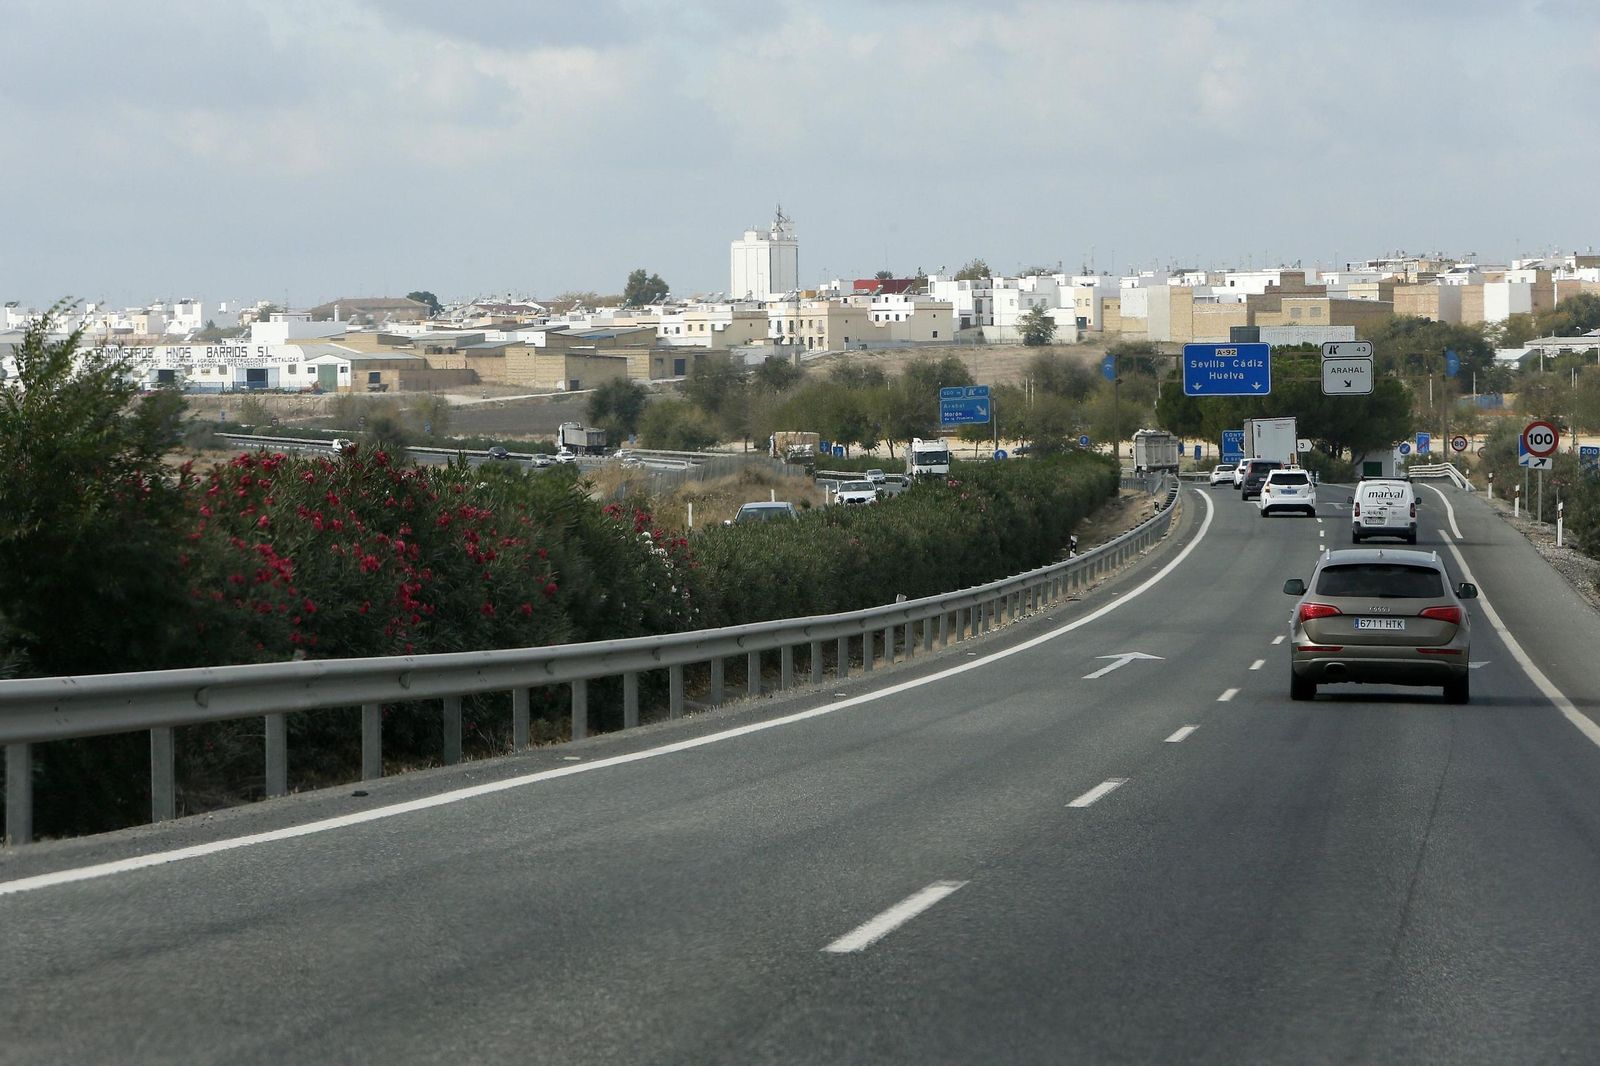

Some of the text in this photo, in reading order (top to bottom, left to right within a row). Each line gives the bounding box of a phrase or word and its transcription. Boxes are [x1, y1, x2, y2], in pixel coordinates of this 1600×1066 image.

[166, 347, 192, 358] HNOS
[206, 346, 248, 358] BARRIOS
[1190, 359, 1263, 368] Sevilla Cádiz
[1209, 371, 1244, 379] Huelva
[1528, 433, 1553, 445] 100
[1368, 489, 1404, 498] marval
[1360, 619, 1403, 629] 6711 HTK
